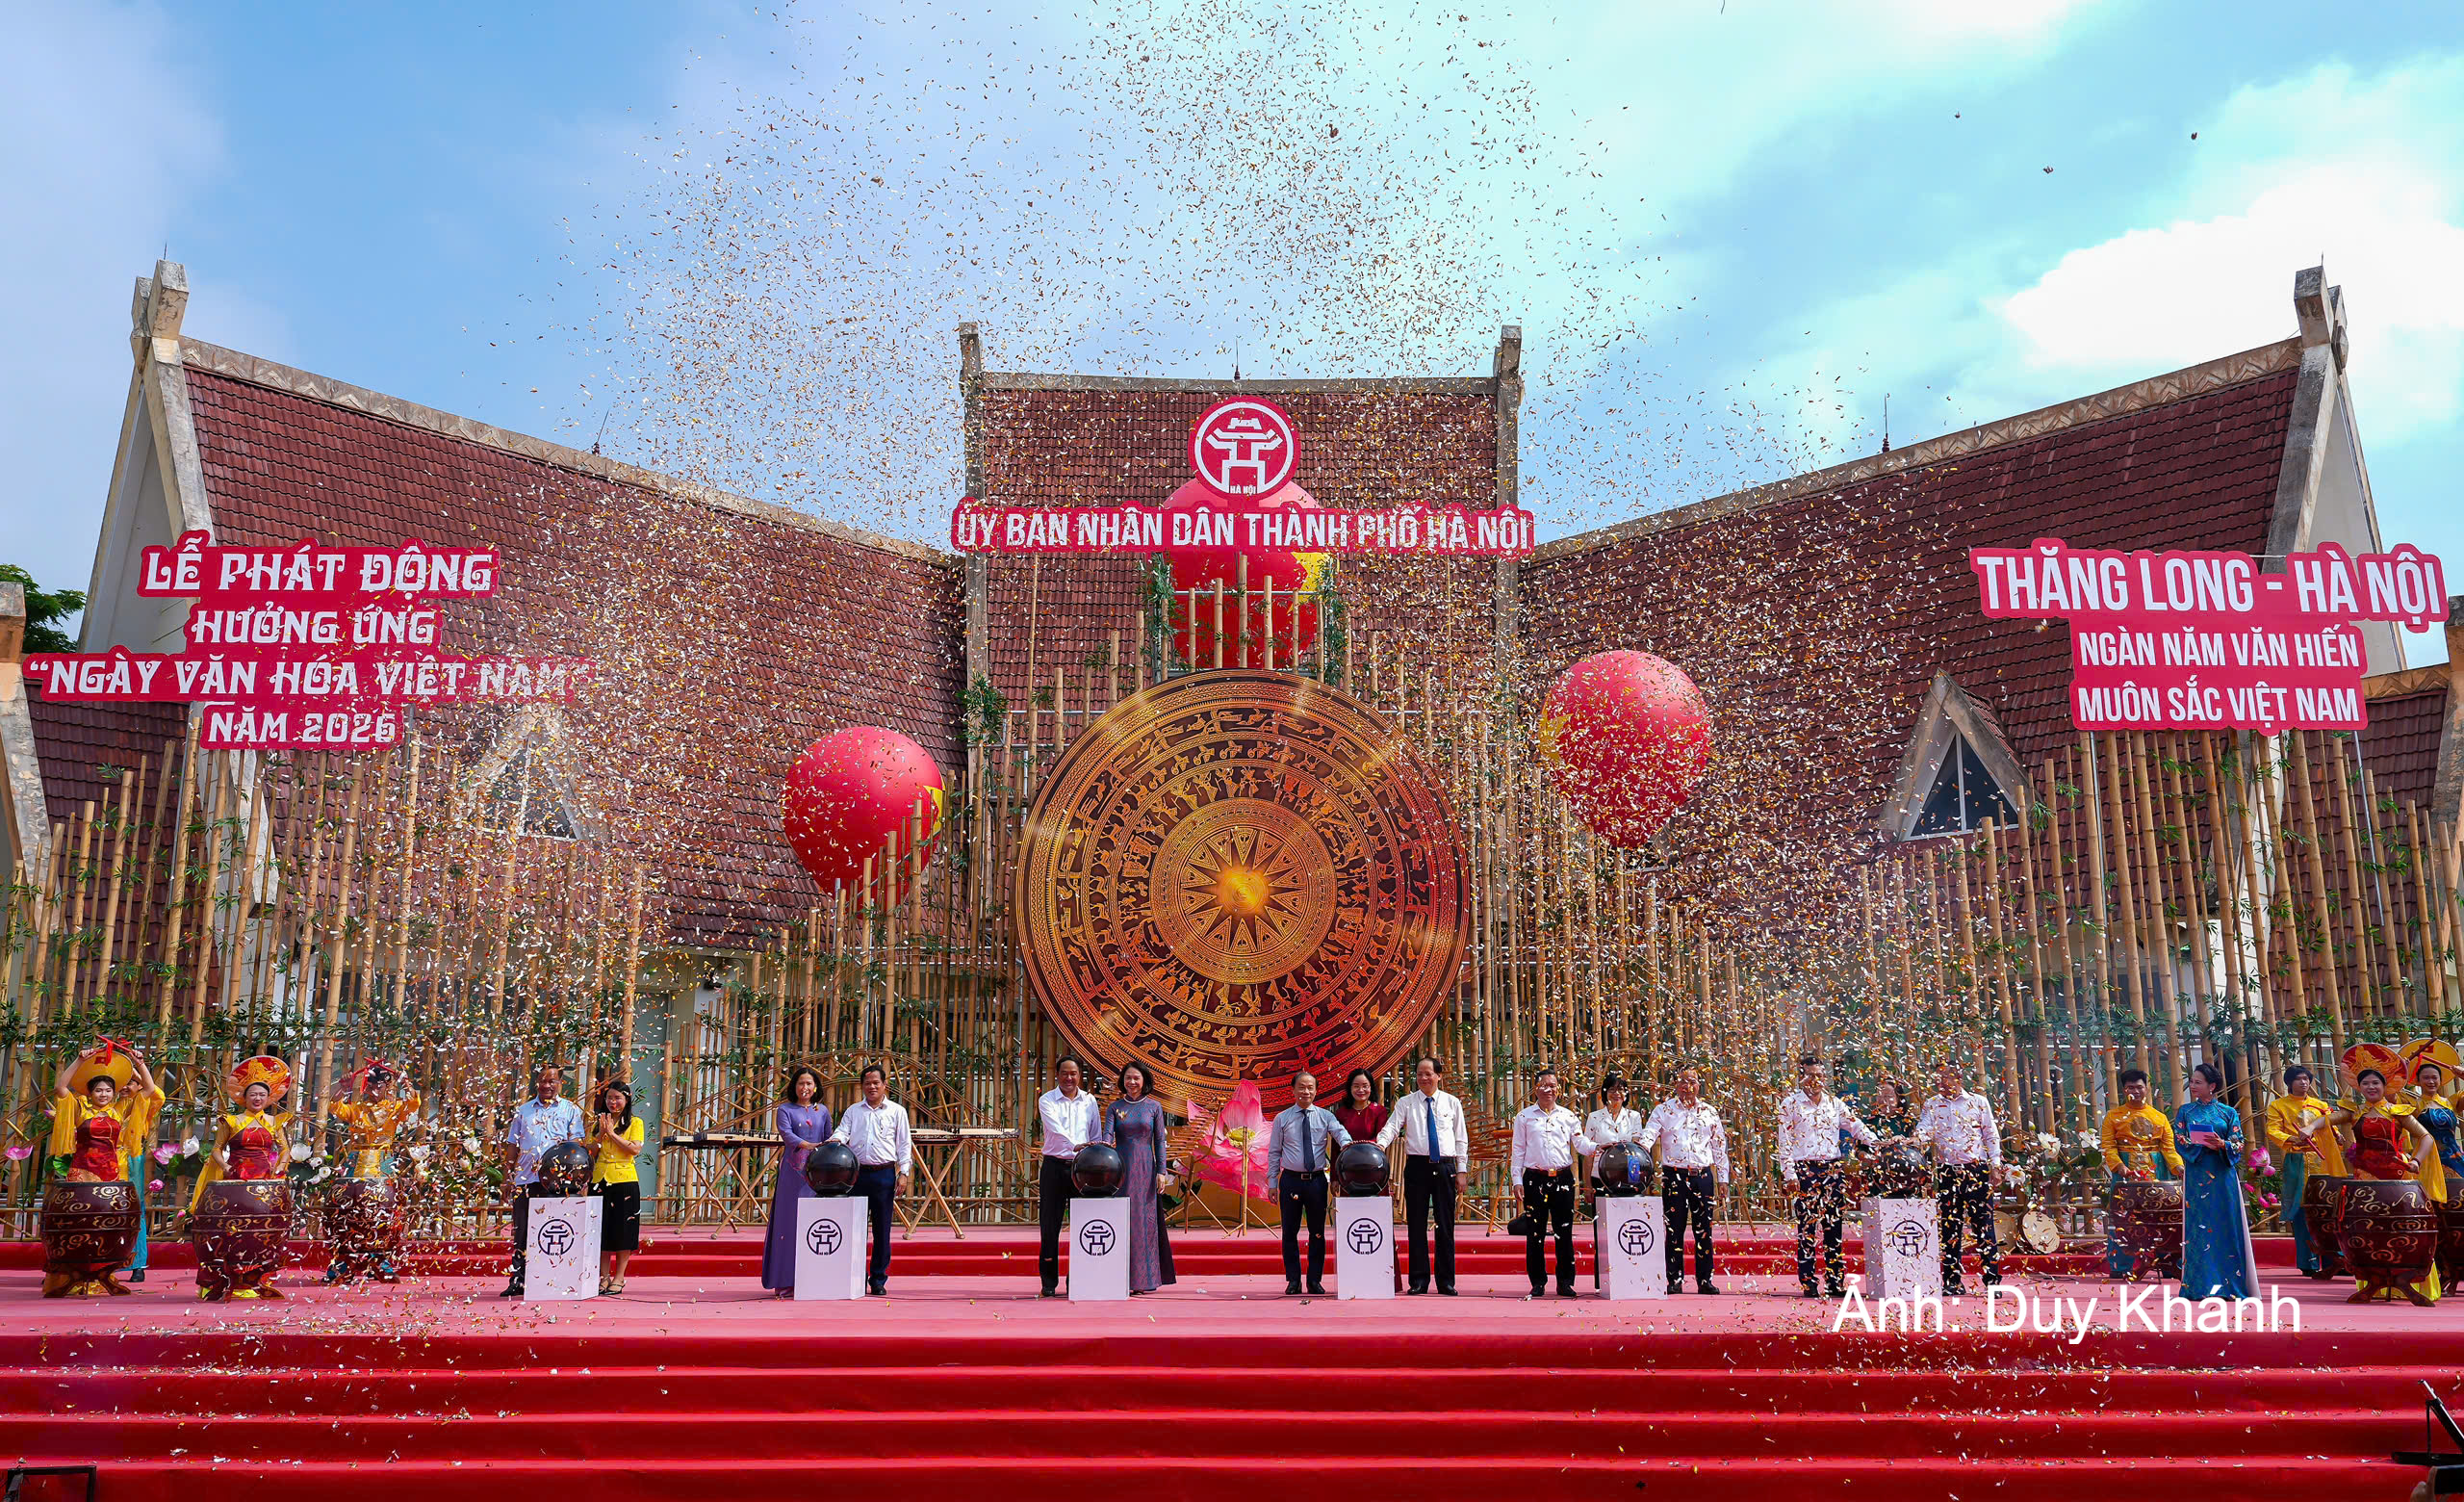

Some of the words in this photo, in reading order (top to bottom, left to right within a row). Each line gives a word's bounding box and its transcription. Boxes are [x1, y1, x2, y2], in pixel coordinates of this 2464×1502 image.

[1229, 483, 1242, 494] HÀ
[959, 504, 997, 546] ỦY
[1007, 512, 1068, 546] BAN
[1077, 506, 1163, 547] NHÂN
[1172, 506, 1234, 546] DÂN
[1244, 507, 1348, 548] THÀNH
[1358, 505, 1424, 549] PHỐ
[1427, 509, 1469, 550] HÀ
[1478, 509, 1528, 556] NỘI
[144, 537, 202, 590] LỄ
[218, 544, 345, 591] PHÁT
[359, 545, 494, 601] ĐỘNG
[1977, 546, 2129, 610] THĂNG
[2140, 557, 2255, 612] LONG
[2267, 582, 2283, 590] -
[2294, 550, 2360, 613] HÀ
[2365, 551, 2442, 625] NỘI
[191, 601, 338, 644] HƯỞNG
[352, 604, 436, 644] ỨNG
[2079, 626, 2157, 666] NGÀN
[2162, 626, 2226, 666] NĂM
[2230, 626, 2289, 666] VĂN
[2294, 624, 2360, 667] HIẾN
[30, 653, 163, 694] “NGÀY
[174, 653, 258, 694] VĂN
[270, 654, 360, 695] HÓA
[2077, 680, 2162, 722] MUÔN
[2167, 674, 2223, 722] SẮC
[2226, 681, 2288, 729] VIỆT
[2295, 687, 2360, 722] NAM
[207, 706, 289, 743] NĂM
